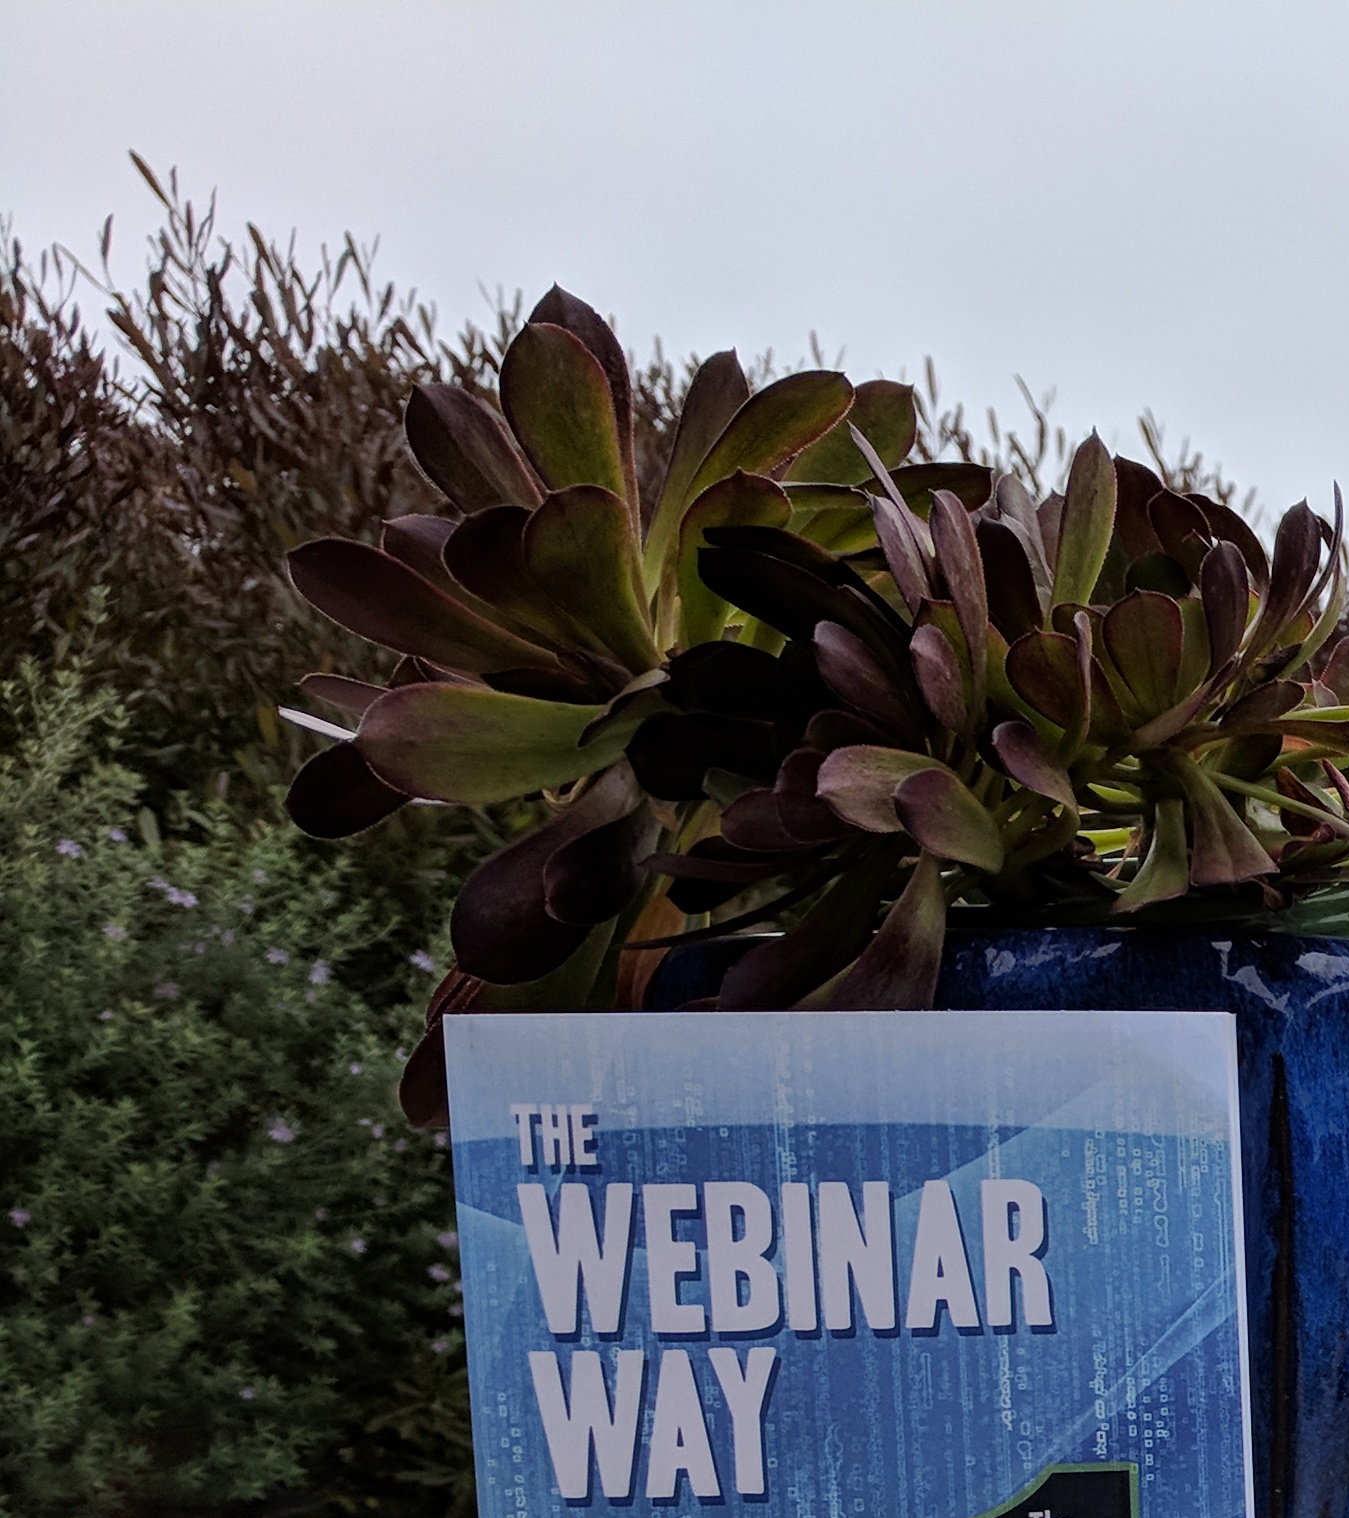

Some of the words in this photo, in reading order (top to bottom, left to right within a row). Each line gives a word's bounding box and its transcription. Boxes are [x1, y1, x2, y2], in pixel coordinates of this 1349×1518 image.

[509, 1103, 597, 1166] THE
[516, 1179, 1054, 1334] WEBINAR
[529, 1347, 776, 1498] WAY
